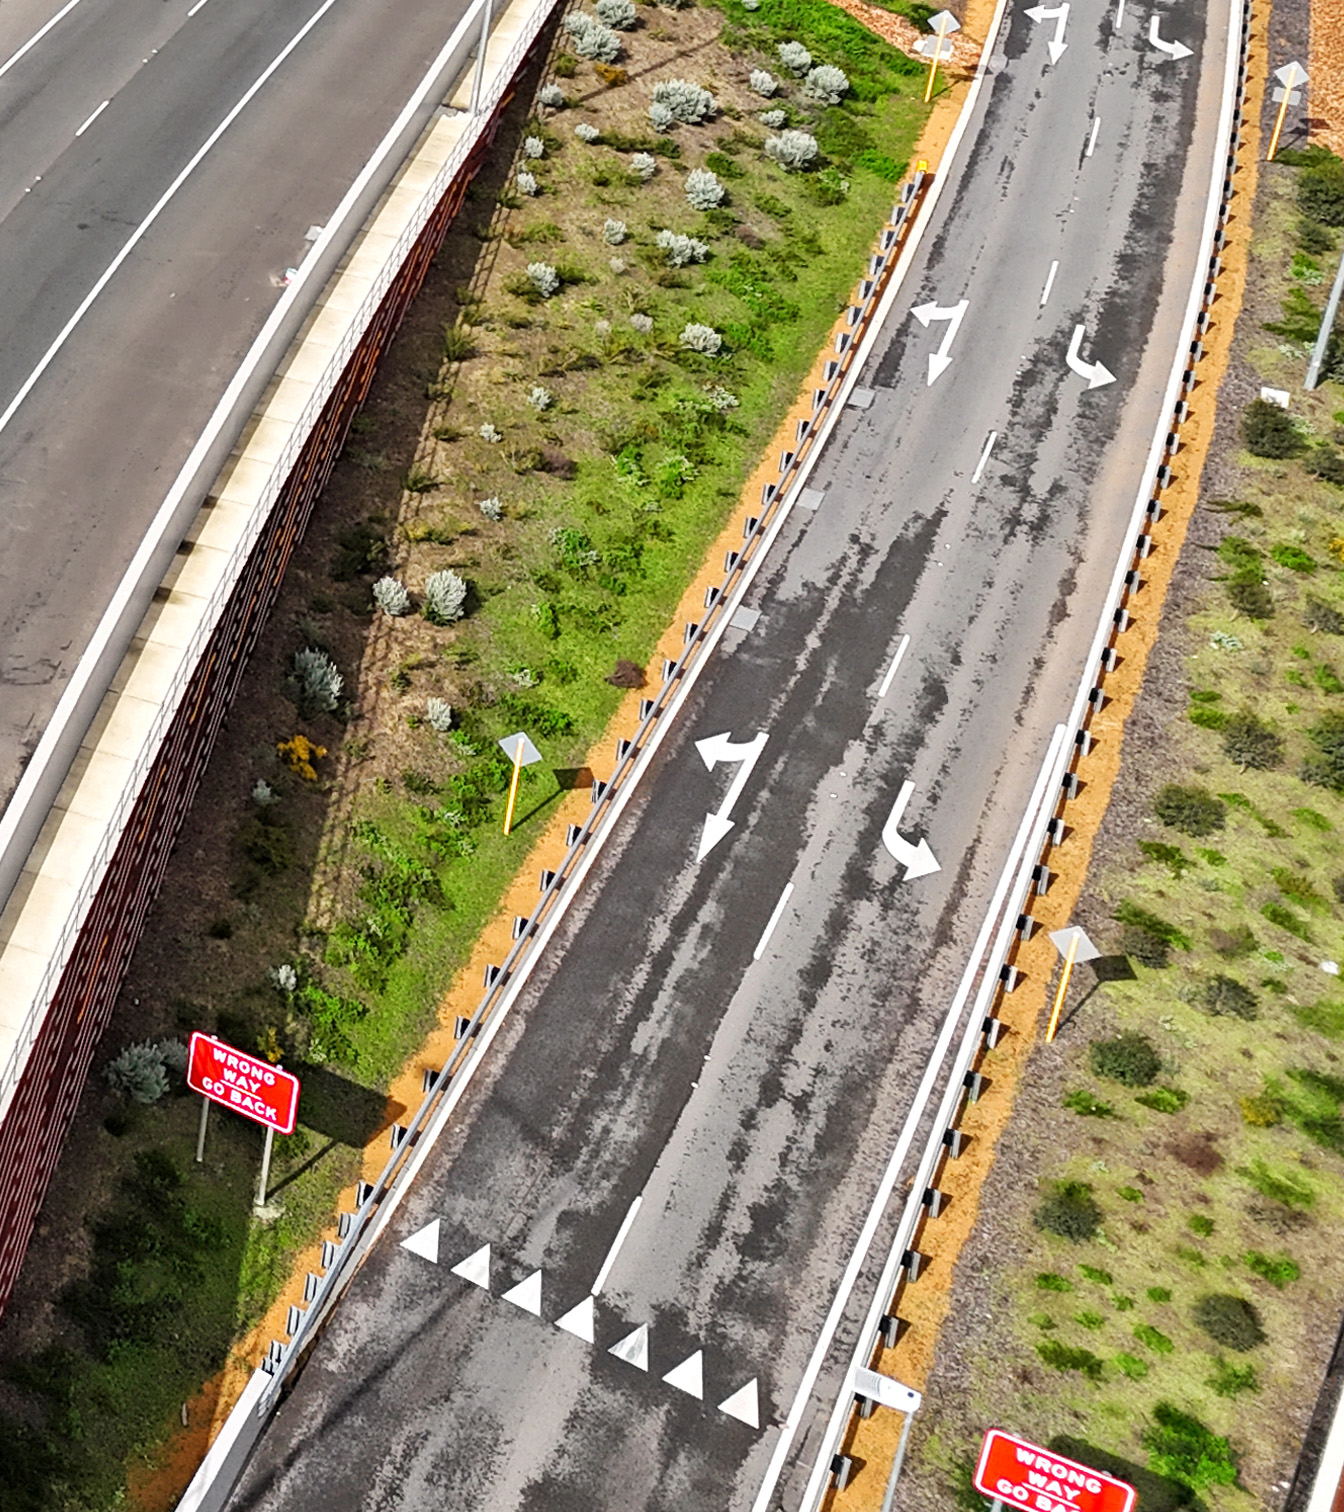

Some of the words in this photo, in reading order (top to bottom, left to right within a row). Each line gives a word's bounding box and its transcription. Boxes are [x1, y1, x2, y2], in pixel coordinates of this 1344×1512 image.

[213, 1048, 276, 1086] WRONG
[223, 1068, 261, 1093] WAY
[202, 1076, 225, 1096] GO
[230, 1089, 277, 1121] BACK
[1016, 1447, 1102, 1494] WRONG
[1028, 1470, 1081, 1501] WAY
[996, 1478, 1029, 1501] GO
